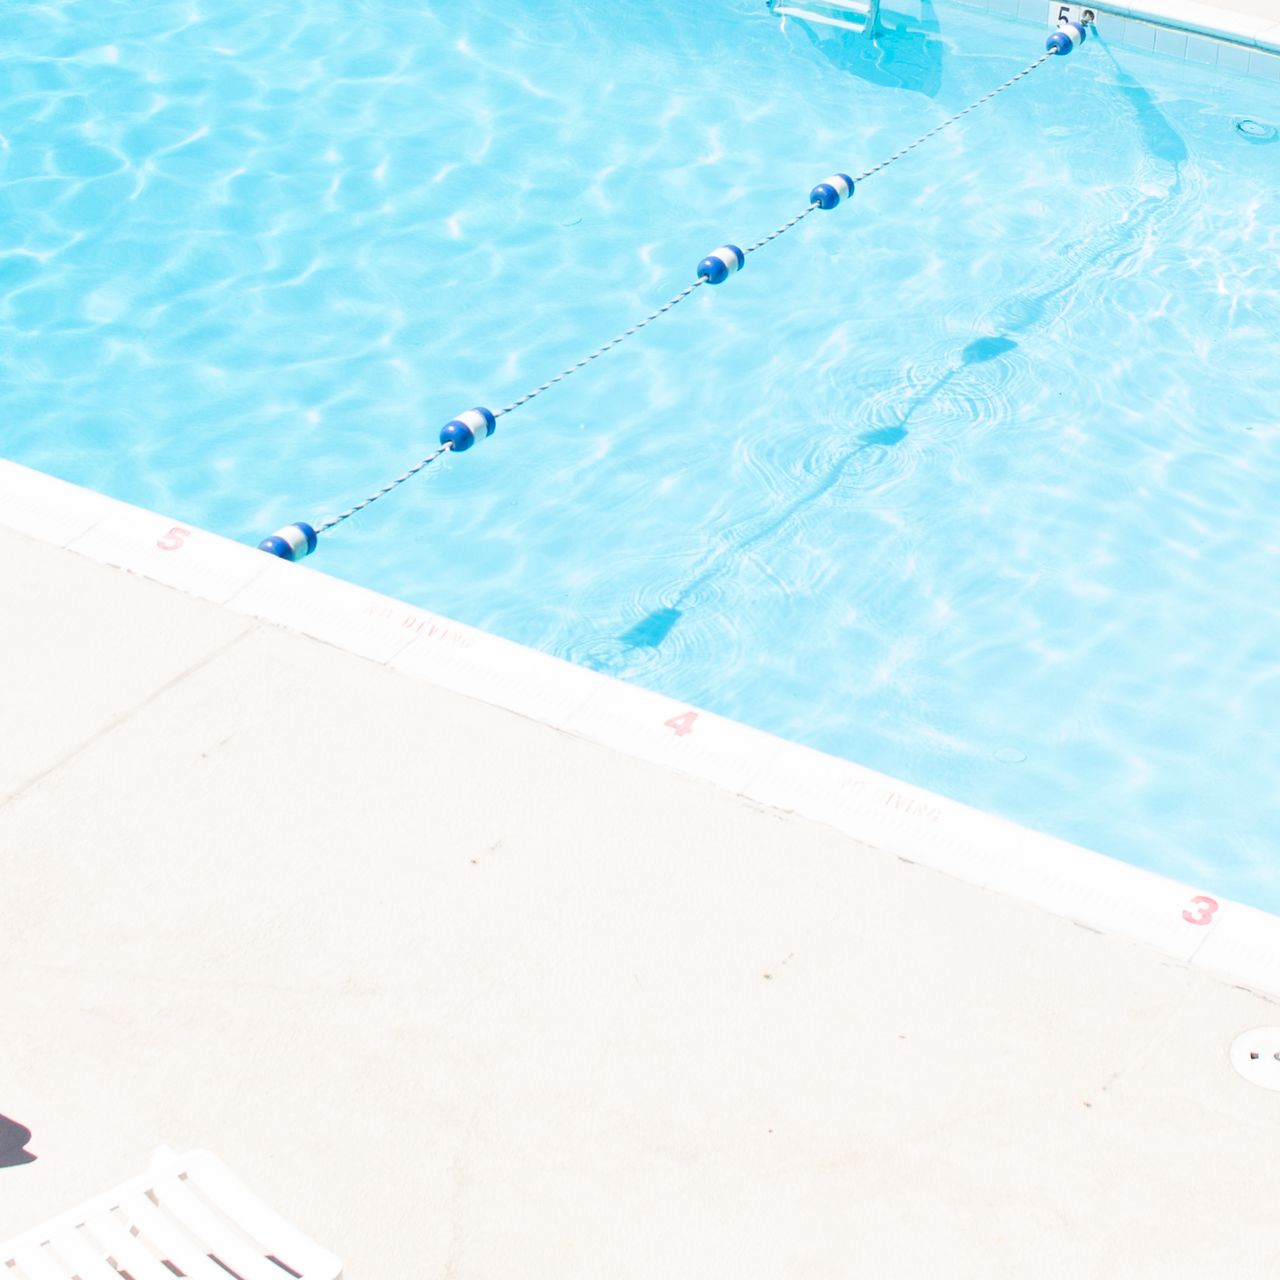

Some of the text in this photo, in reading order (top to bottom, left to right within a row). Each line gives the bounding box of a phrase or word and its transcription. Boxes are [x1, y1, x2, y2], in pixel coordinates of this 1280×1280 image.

[1057, 6, 1071, 27] 5
[155, 526, 192, 552] 5
[664, 710, 699, 736] 4
[1181, 894, 1219, 926] 3
